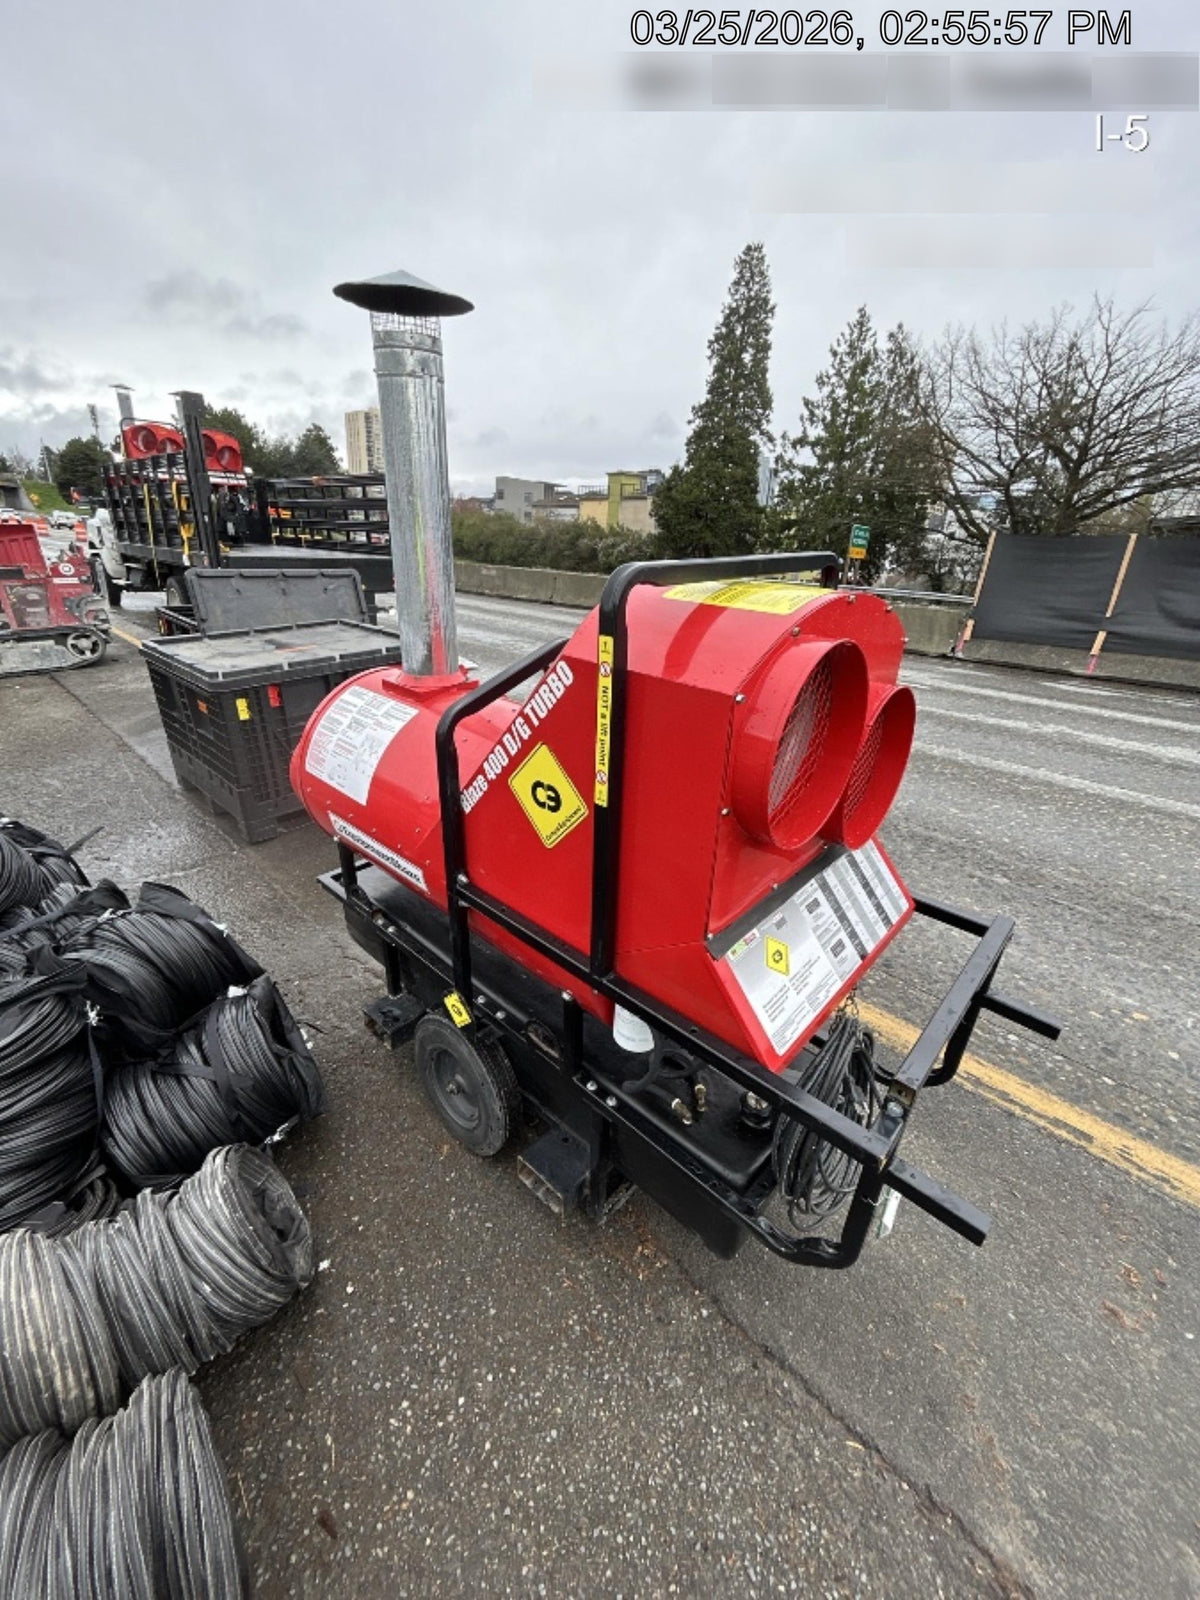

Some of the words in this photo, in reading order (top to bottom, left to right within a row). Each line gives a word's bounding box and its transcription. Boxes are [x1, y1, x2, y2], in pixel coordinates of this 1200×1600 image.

[483, 744, 510, 780] 400
[502, 717, 533, 757] D/G
[523, 660, 575, 728] TURBO
[601, 685, 609, 712] NOT
